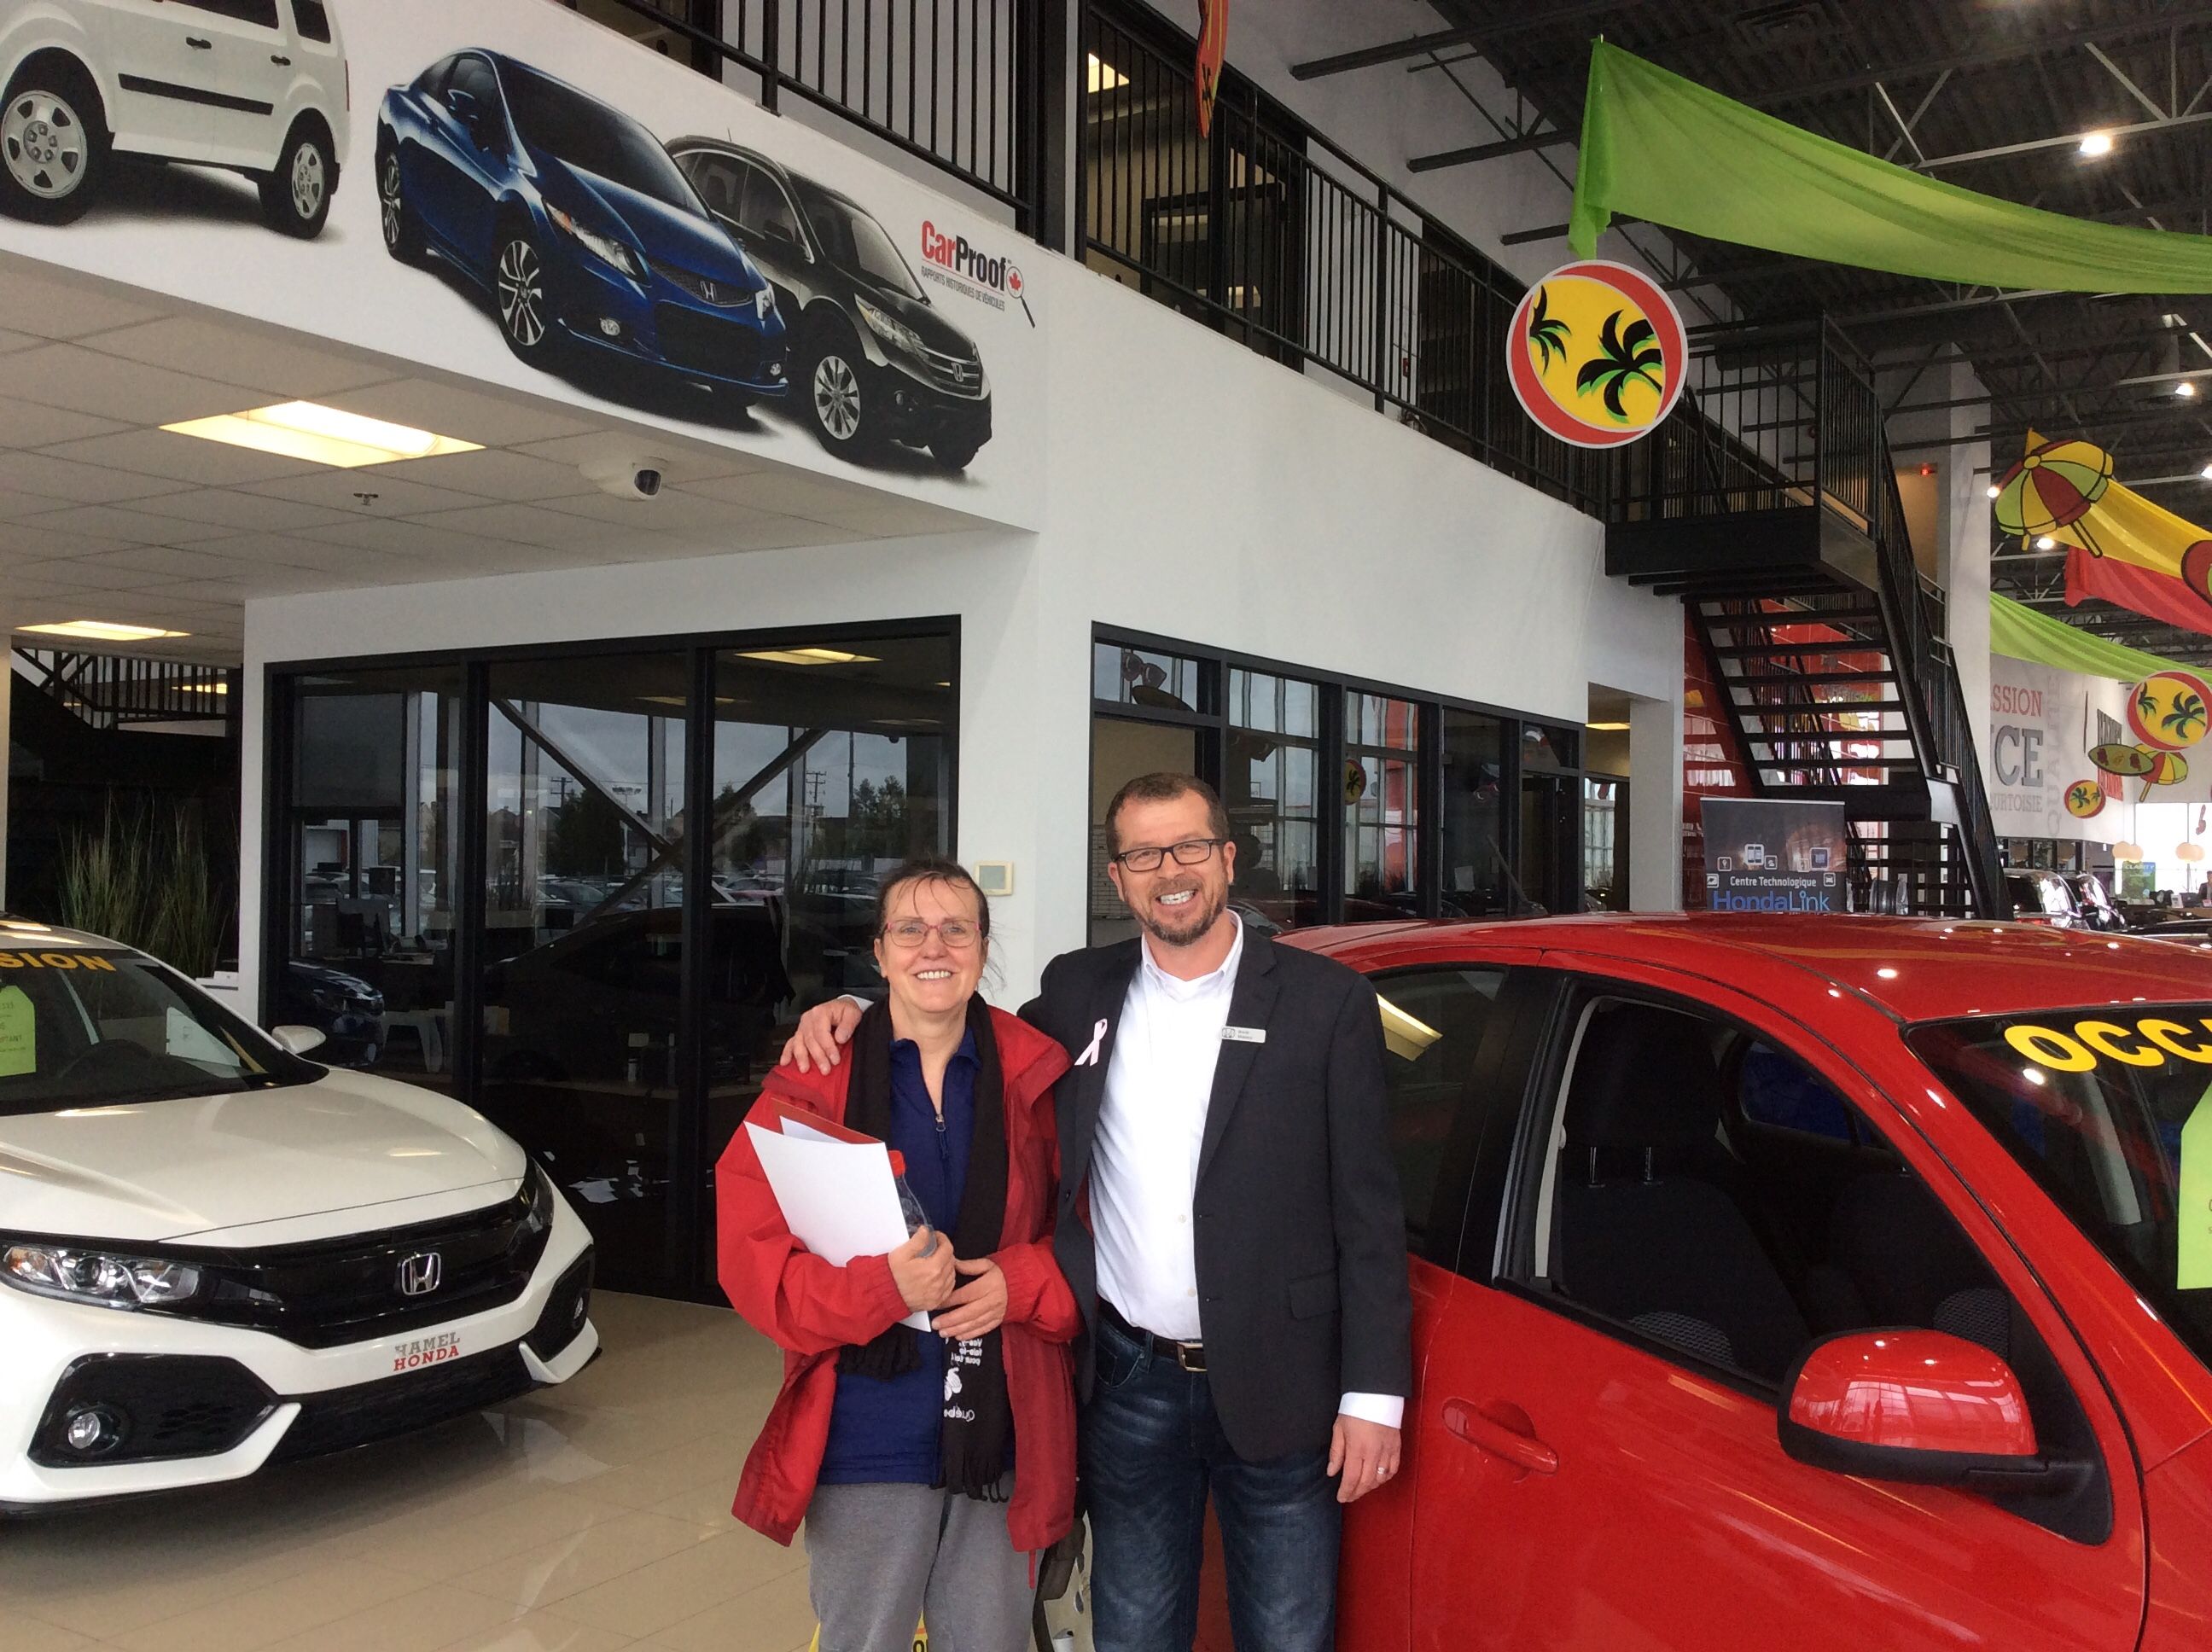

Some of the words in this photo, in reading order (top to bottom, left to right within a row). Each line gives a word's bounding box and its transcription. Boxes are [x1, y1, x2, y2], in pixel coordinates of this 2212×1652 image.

[922, 220, 1006, 292] CarProof
[921, 265, 945, 286] RAPPORTS
[946, 276, 975, 299] HISTORIQUES
[975, 288, 982, 301] DE
[1990, 683, 2043, 717] SSION
[1990, 724, 2044, 788] CE
[1730, 875, 1757, 887] Centre
[1759, 875, 1817, 889] Technologique
[1712, 890, 1831, 911] HondaLink
[393, 1345, 459, 1371] HONDA
[395, 1331, 460, 1357] HAMEL
